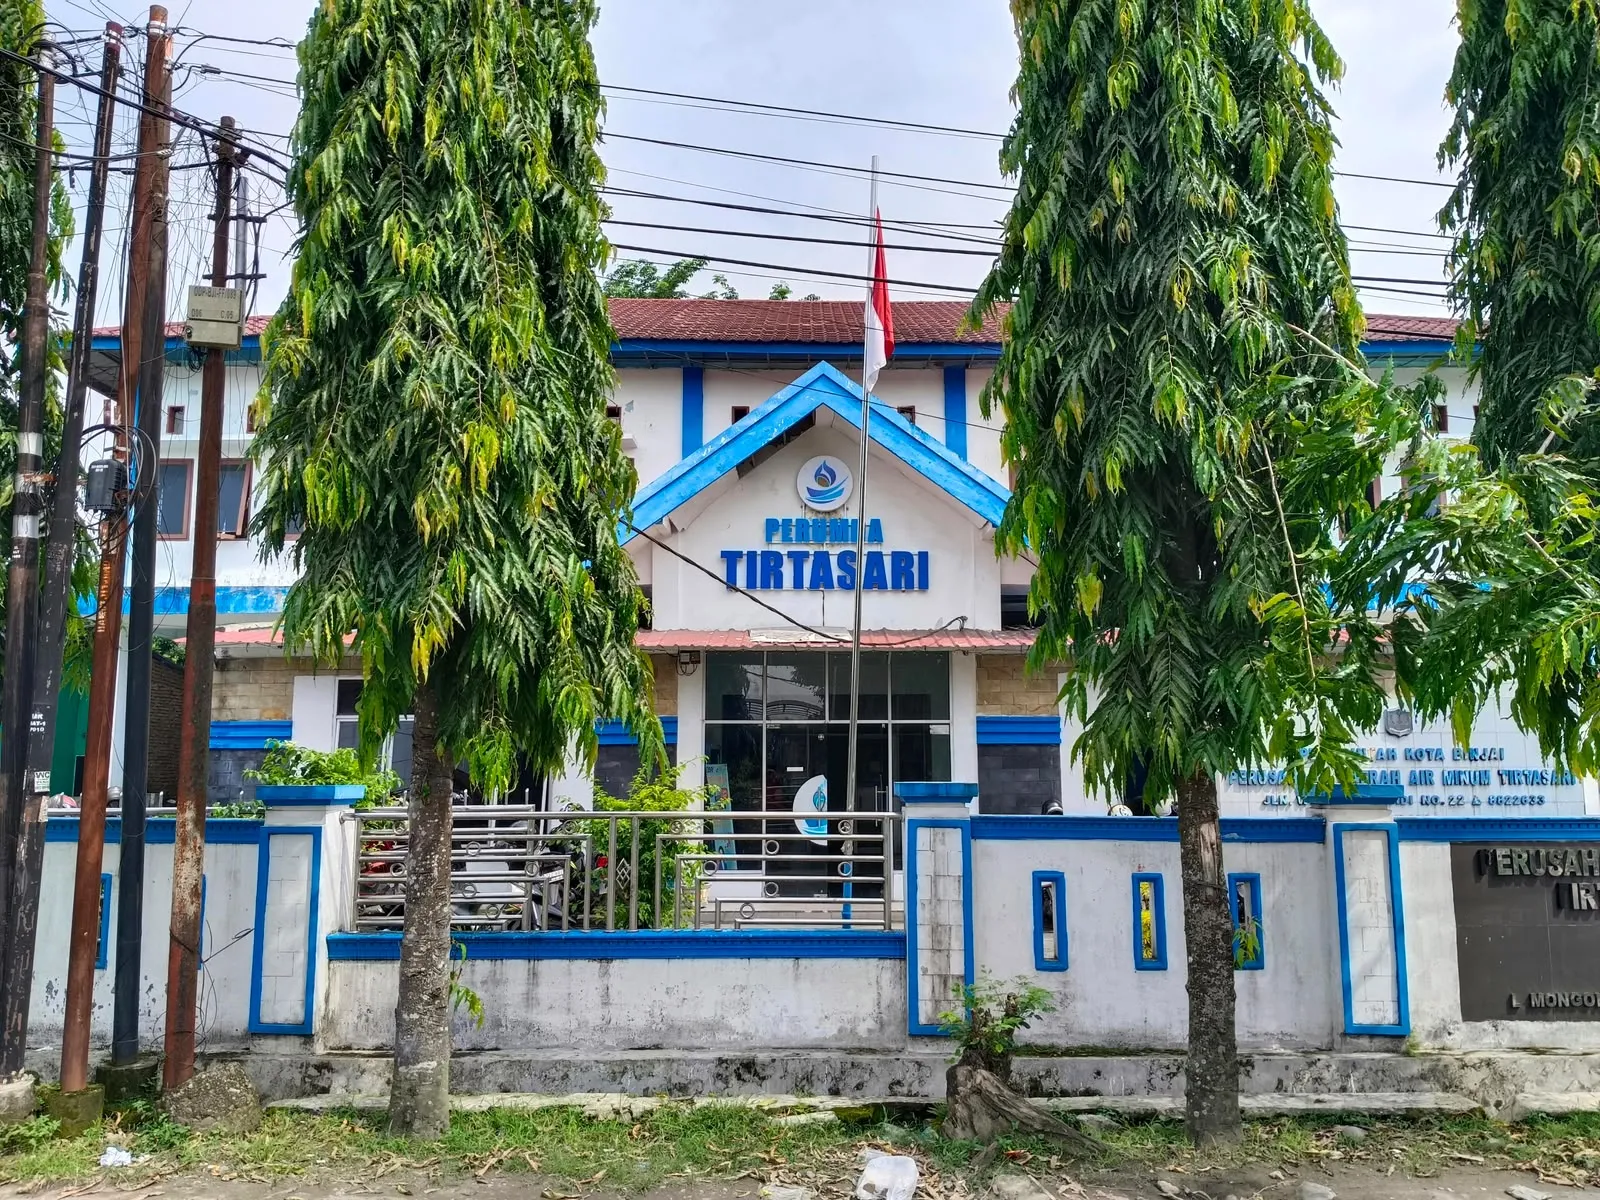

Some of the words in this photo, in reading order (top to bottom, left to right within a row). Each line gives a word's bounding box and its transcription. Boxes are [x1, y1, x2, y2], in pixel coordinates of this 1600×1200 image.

[720, 550, 929, 590] TIRTASARI
[1403, 746, 1445, 762] KOTA
[35, 771, 50, 779] WC
[1408, 768, 1435, 786] AIR
[1441, 768, 1492, 786] MINUM
